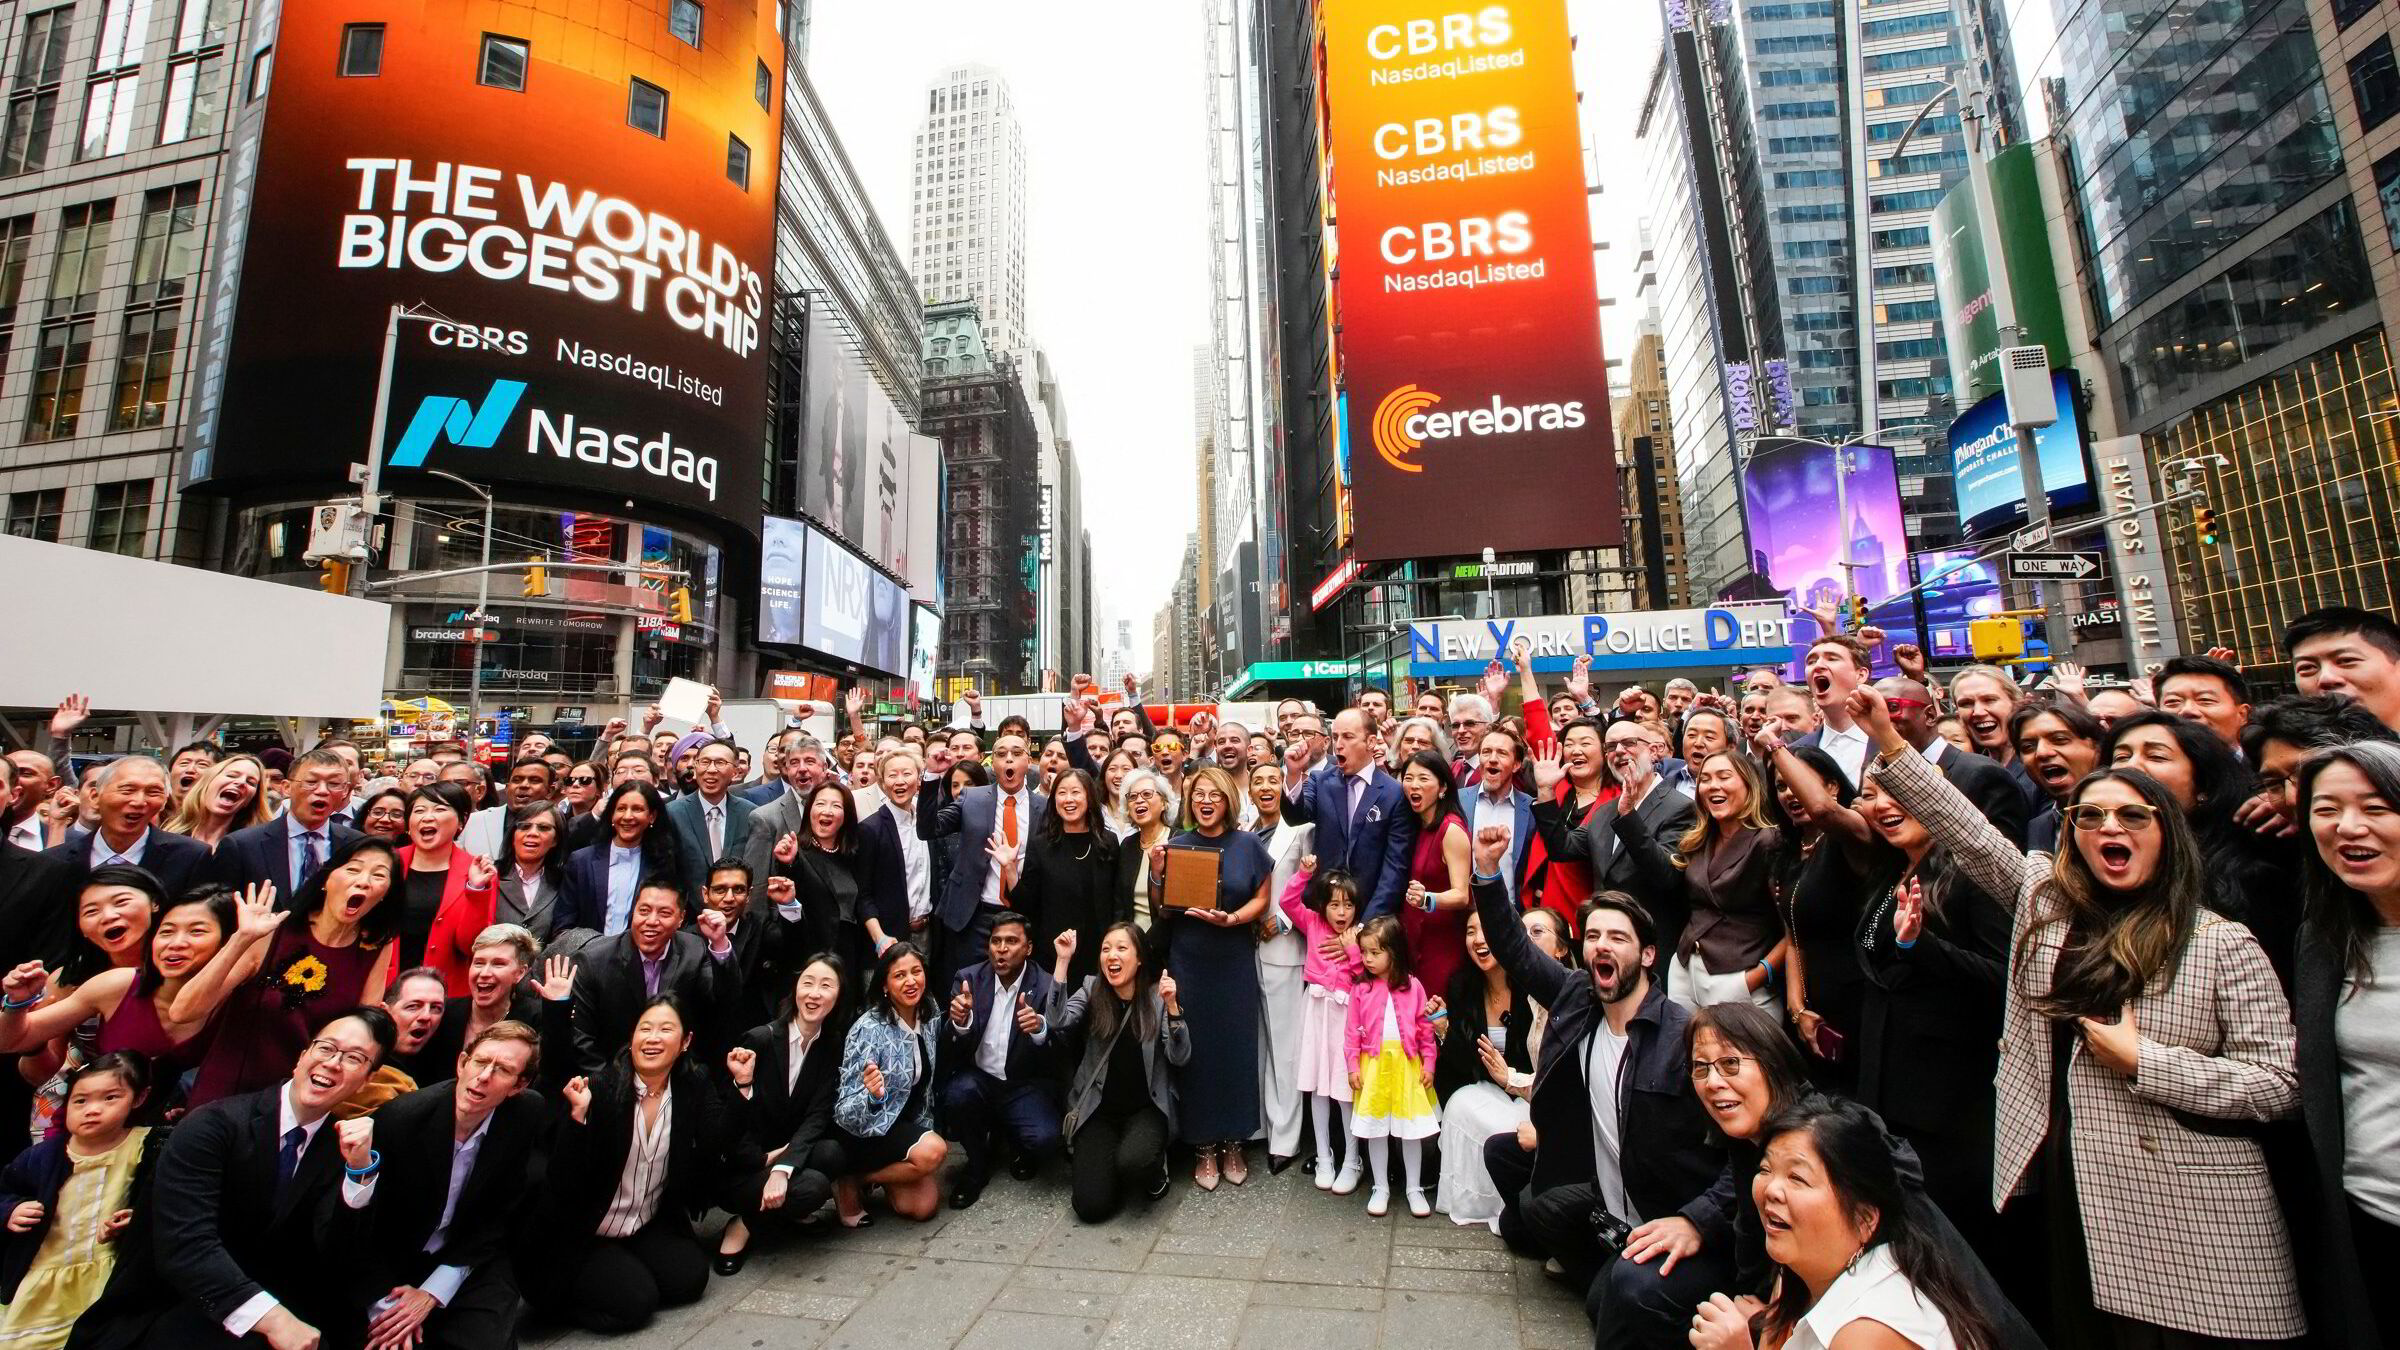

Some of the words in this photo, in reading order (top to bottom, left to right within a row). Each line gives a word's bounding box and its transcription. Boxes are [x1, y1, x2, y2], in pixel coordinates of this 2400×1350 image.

[1367, 7, 1514, 61] CBRS
[1371, 48, 1525, 87] NasdaqListed
[1373, 106, 1522, 161] CBRS
[1377, 151, 1535, 188] NasdaqListed
[346, 158, 501, 221] THE
[515, 175, 762, 320] WORLD'S
[1380, 212, 1533, 265] CBRS
[339, 214, 664, 312] BIGGEST
[664, 268, 760, 359] CHIP
[1384, 258, 1545, 293] NasdaqListed
[428, 320, 529, 355] CBRS
[557, 338, 723, 407] NasdaqListed
[1978, 347, 2001, 367] Airtab
[1727, 365, 1754, 429] ROKU
[1404, 394, 1586, 441] cerebras
[528, 408, 719, 502] Nasdaq
[2108, 456, 2143, 552] SQUARE
[2016, 536, 2028, 549] ONE
[2031, 528, 2045, 542] WAY
[1455, 562, 1534, 578] NEWTDITION
[2021, 560, 2048, 572] ONE
[2059, 561, 2087, 572] WAY
[761, 587, 801, 599] SCIENCE.
[769, 600, 792, 610] LIFE.
[2129, 574, 2161, 649] TIMES
[415, 628, 465, 640] branded
[464, 613, 500, 624] Ndaq
[516, 617, 554, 627] REWRITE
[558, 619, 604, 630] TOMORROW
[1411, 624, 1483, 663] NEW
[1487, 620, 1575, 660] YORK
[1583, 615, 1693, 656] POLICE
[1705, 609, 1794, 650] DEPT
[502, 668, 549, 682] Nasdaq
[2144, 662, 2163, 675] 3
